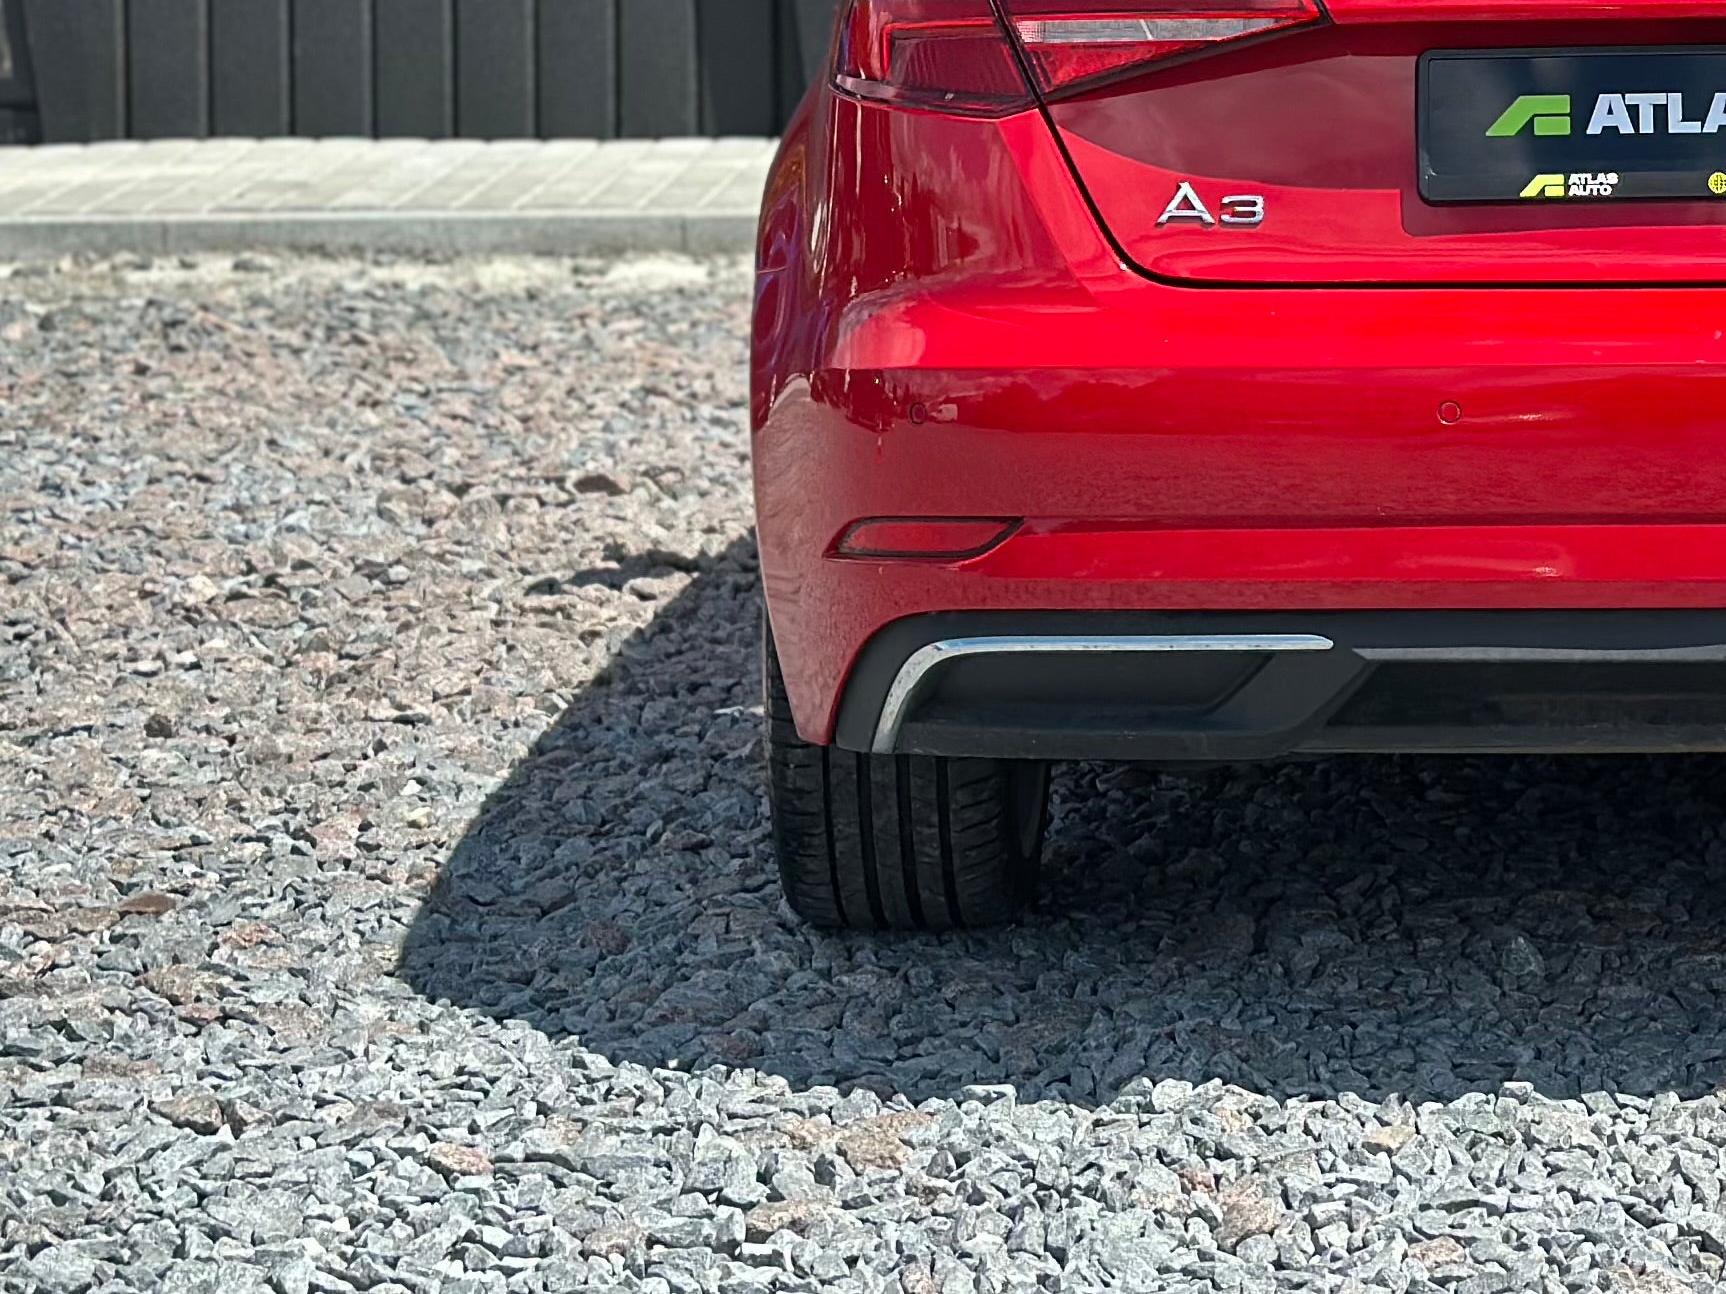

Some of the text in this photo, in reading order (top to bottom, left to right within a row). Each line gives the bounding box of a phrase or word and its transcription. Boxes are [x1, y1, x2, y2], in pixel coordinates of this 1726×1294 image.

[1568, 173, 1618, 184] ATLAS
[1568, 185, 1612, 196] AUTO
[1156, 181, 1265, 225] A3
